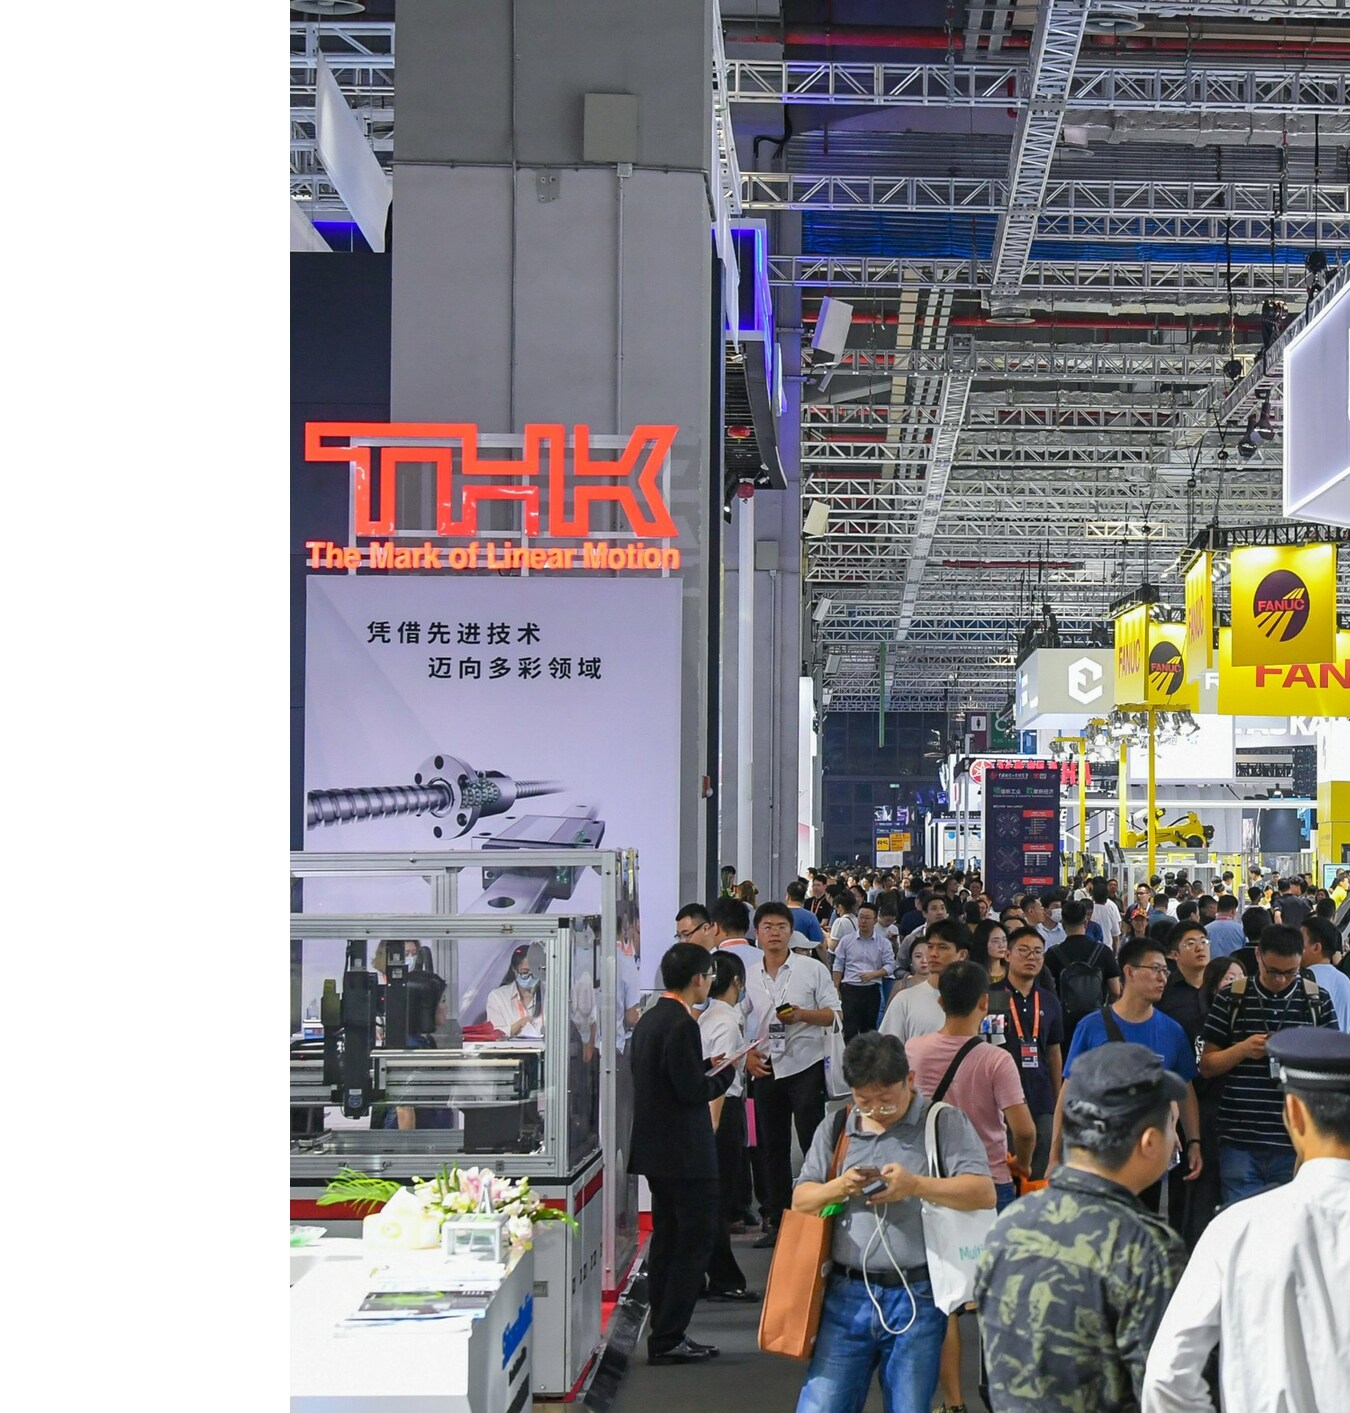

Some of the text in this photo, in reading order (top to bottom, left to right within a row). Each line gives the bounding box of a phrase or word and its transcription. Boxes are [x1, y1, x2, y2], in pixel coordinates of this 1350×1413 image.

[305, 421, 679, 537] THK
[306, 541, 681, 570] The Mark of Linear Motion
[1257, 599, 1306, 612] FANUC
[367, 620, 541, 645] 凭借先进技术
[428, 656, 603, 681] 迈向多彩领域
[1118, 638, 1141, 678] FANUC
[1151, 662, 1182, 674] FANUC
